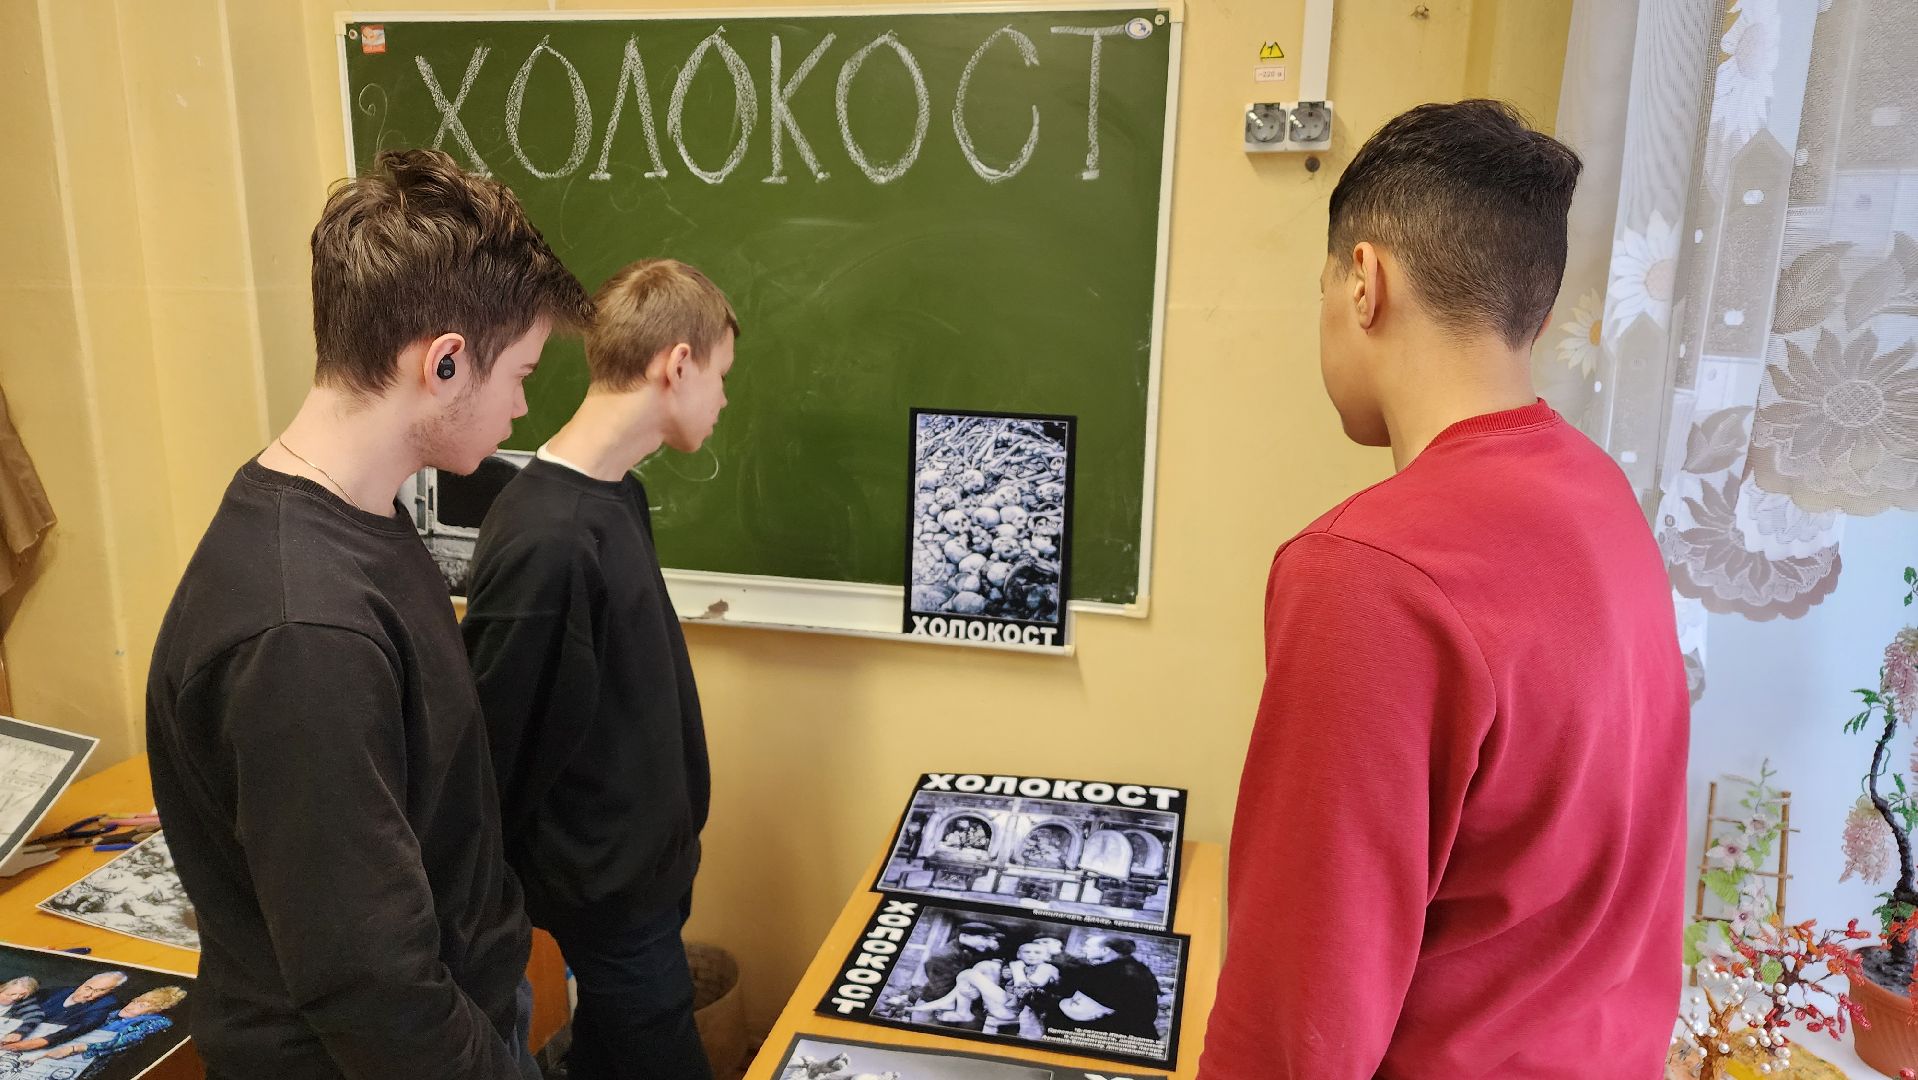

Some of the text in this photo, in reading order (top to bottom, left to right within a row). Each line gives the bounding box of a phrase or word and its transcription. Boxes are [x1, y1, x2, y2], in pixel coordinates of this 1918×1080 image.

[414, 25, 1126, 184] ХОЛОКОСТ
[911, 615, 1057, 646] ХОЛОКОСТ
[922, 773, 1180, 810] ХОЛОКОСТ
[831, 900, 919, 1015] ХОЛОКОСТ
